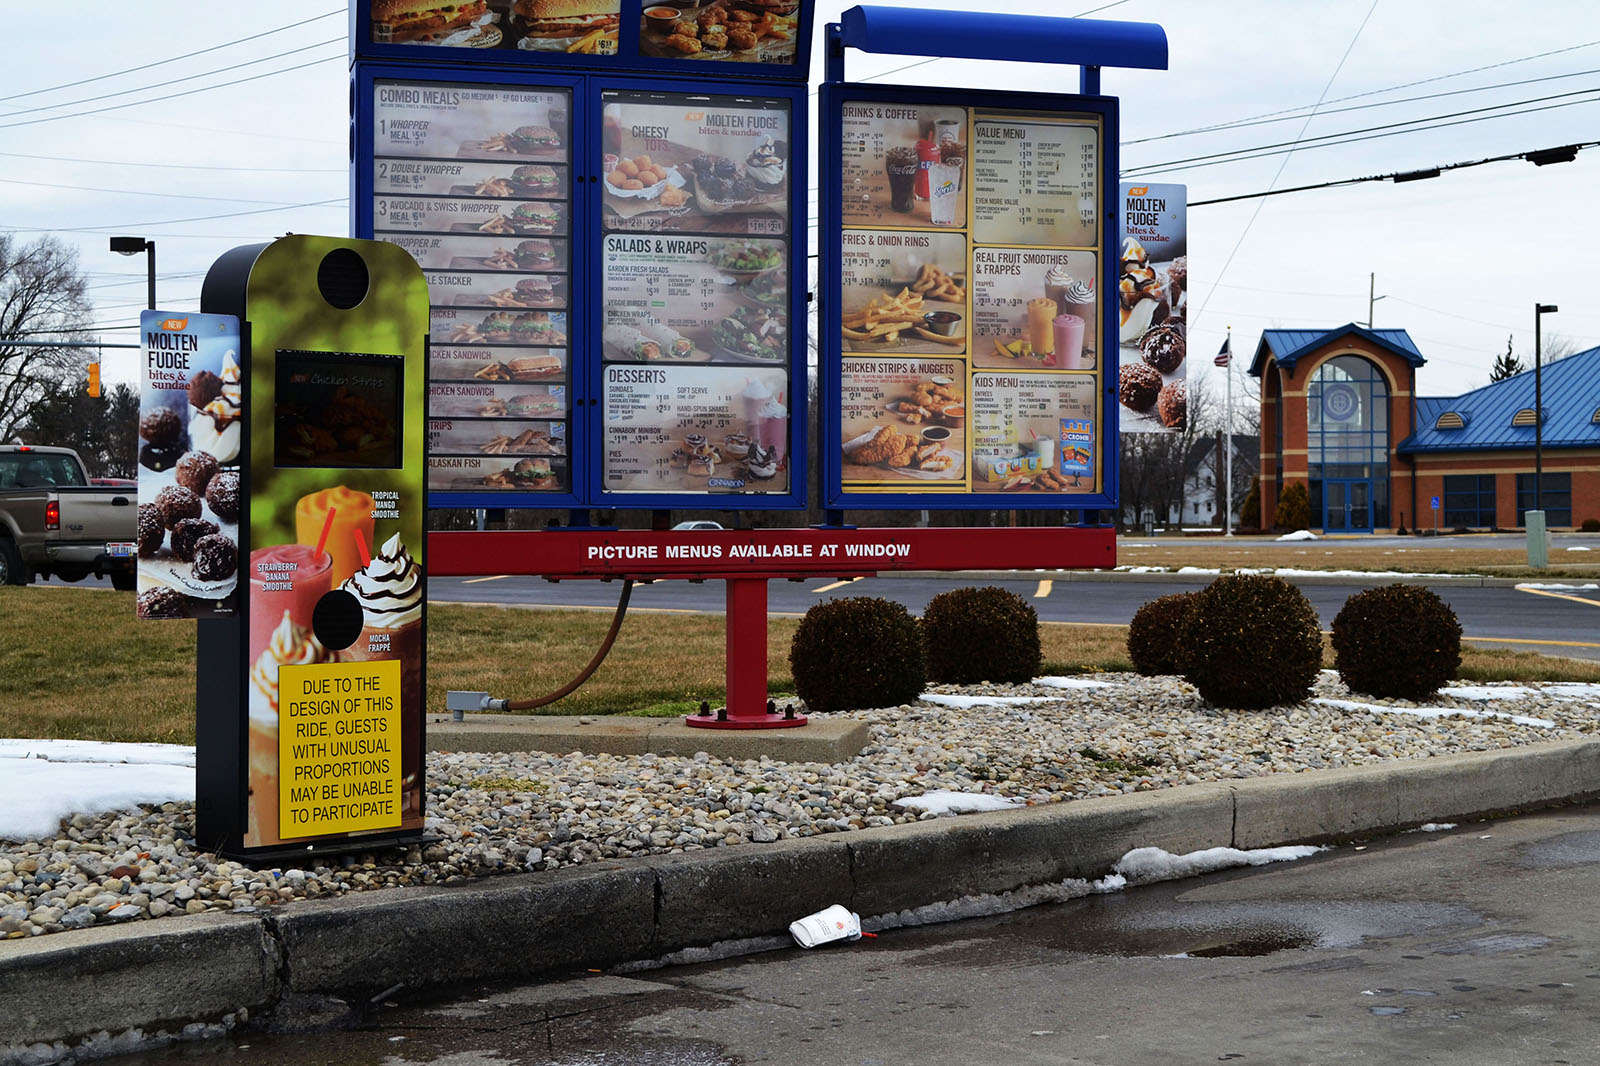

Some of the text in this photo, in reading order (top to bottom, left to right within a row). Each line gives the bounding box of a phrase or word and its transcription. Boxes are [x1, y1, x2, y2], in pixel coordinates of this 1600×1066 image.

[380, 88, 420, 104] COMBO
[423, 90, 460, 106] MEALS
[842, 107, 918, 120] DRINKS & COFFEE
[380, 120, 431, 135] 1 WHOPPER
[706, 114, 778, 129] MOLTEN FUDGE
[390, 130, 410, 140] MEAL
[632, 125, 669, 138] CHEESY
[731, 128, 761, 137] sundae
[976, 127, 1026, 139] VALUE MENU
[379, 163, 463, 179] 2 DOUBLE WHOPPER
[390, 174, 410, 183] MEAL
[934, 185, 956, 198] Sprite
[379, 200, 500, 216] 3 AVOCADO & SWISS WHOPPER
[1126, 198, 1165, 213] MOLTEN
[390, 212, 410, 220] MEAL
[1126, 213, 1159, 226] FUDGE
[1126, 226, 1146, 235] bites
[842, 234, 929, 247] FRIES & ONION RINGS
[1139, 233, 1169, 242] sundae
[608, 238, 707, 255] SALADS & WRAPS
[976, 253, 1068, 265] REAL FRUIT SMOOTHIES
[976, 263, 1021, 276] & FRAPPÉS
[438, 276, 472, 286] STACKER
[431, 310, 457, 318] HICKEN
[168, 320, 183, 330] NEW
[148, 333, 198, 352] MOLTEN
[148, 352, 190, 370] FUDGE
[432, 350, 491, 360] CKEN SANDWICH
[842, 362, 954, 374] CHICKEN STRIPS & NUGGETS
[148, 370, 186, 381] bites &
[310, 372, 384, 388] Chicken Strips
[608, 369, 666, 384] DESSERTS
[152, 381, 190, 391] sundae
[975, 378, 993, 387] KIDS
[996, 378, 1018, 388] MENU
[429, 387, 494, 396] HICKEN SANDWICH
[430, 421, 452, 430] TRIPS
[429, 459, 480, 468] ALASKAN FISH
[372, 492, 400, 500] TROPICAL
[375, 501, 396, 509] MANGO
[371, 510, 400, 519] SMOOTHIE
[588, 544, 910, 559] PICTURE MENUS AVAILABLE AT WINDOW
[257, 563, 298, 573] STRAWBERRY
[265, 573, 290, 582] BANANA
[262, 582, 293, 592] SMOOTHIE
[370, 634, 390, 644] MOCHA
[368, 642, 391, 652] FRAPPÉ
[303, 676, 380, 694] DUE TO THE
[290, 696, 393, 717] DESIGN OF THIS
[297, 718, 387, 738] RIDE, GUESTS
[292, 739, 391, 759] WITH UNUSUAL
[295, 759, 390, 780] PROPORTIONS
[291, 780, 393, 803] MAY BE UNABLE
[291, 800, 393, 824] TO PARTICIPATE
